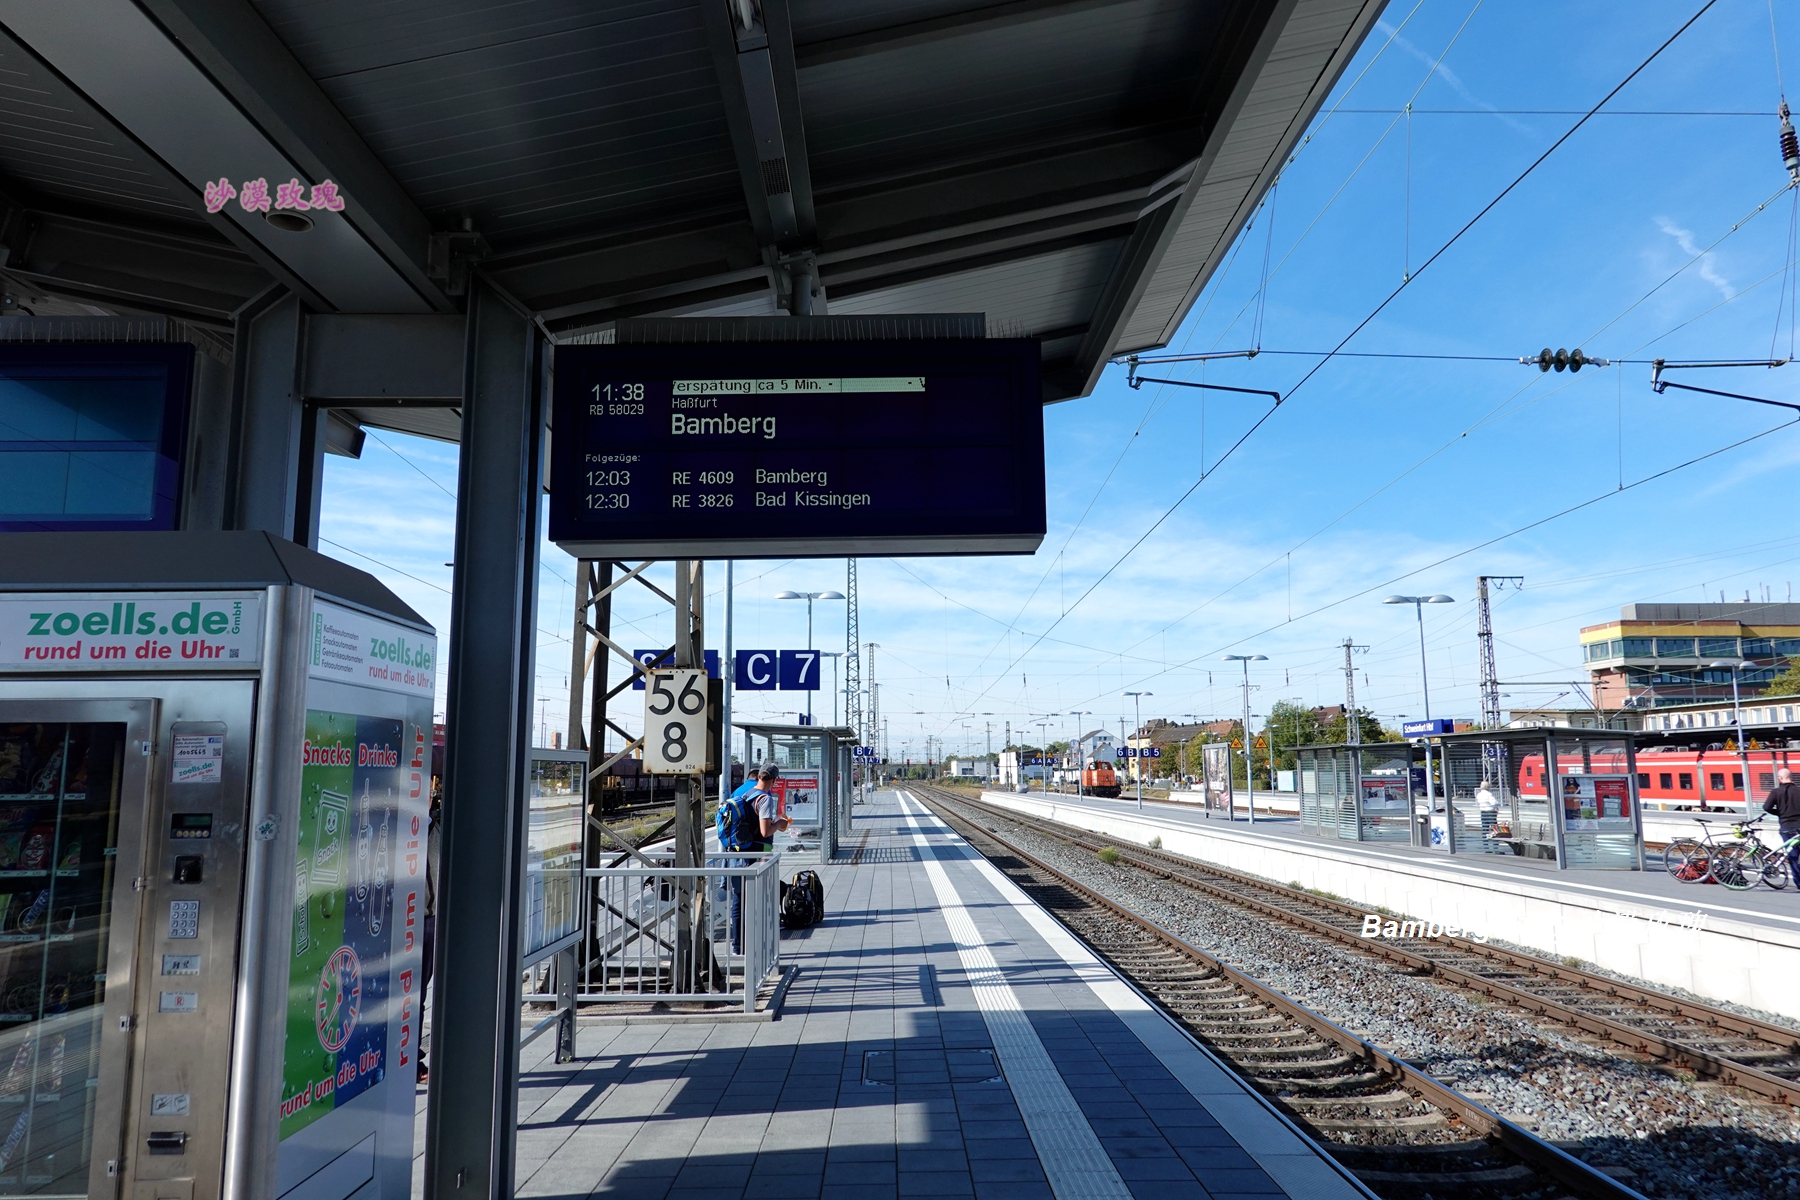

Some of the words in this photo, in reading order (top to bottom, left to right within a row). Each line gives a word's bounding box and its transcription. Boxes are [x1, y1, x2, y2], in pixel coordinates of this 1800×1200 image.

[591, 383, 644, 401] 11:38
[672, 380, 750, 393] erspätung
[758, 382, 774, 390] ca
[780, 380, 788, 390] 5
[794, 379, 822, 390] Min.
[672, 398, 718, 408] Haßfurt
[590, 404, 604, 415] RB
[608, 404, 644, 415] 58029
[672, 413, 776, 440] Bamberg
[585, 454, 641, 464] Folgezüge:
[586, 470, 630, 486] 12:03
[672, 471, 691, 484] RE
[698, 471, 734, 484] 4609
[756, 469, 828, 486] Bamberg
[585, 494, 630, 508] 12:30
[672, 494, 691, 508] RE
[698, 494, 734, 508] 3826
[756, 491, 786, 506] Bad
[794, 490, 870, 510] Kissingen
[26, 602, 229, 636] zoells.de
[232, 602, 242, 634] GmbH
[24, 640, 82, 660] rund
[90, 646, 126, 658] um
[134, 640, 172, 658] die
[181, 640, 226, 658] Uhr
[370, 636, 430, 670] zoells.de
[368, 664, 388, 680] rund
[390, 670, 402, 683] um
[404, 669, 415, 686] die
[416, 672, 430, 689] Uhr
[748, 654, 770, 684] C
[795, 654, 814, 684] 7
[648, 674, 705, 715] 56
[303, 740, 350, 766] Snacks
[358, 742, 398, 767] Drinks
[662, 722, 688, 763] 8
[1118, 748, 1124, 756] 6
[1128, 748, 1134, 756] B
[1143, 748, 1150, 756] B
[1154, 748, 1160, 756] 5
[410, 726, 424, 799] Uhr
[406, 815, 420, 876] die
[404, 892, 416, 954] um
[400, 968, 413, 1068] rund
[280, 1081, 312, 1119] rund
[316, 1076, 334, 1100] um
[337, 1060, 356, 1087] die
[360, 1050, 380, 1071] Uhr
